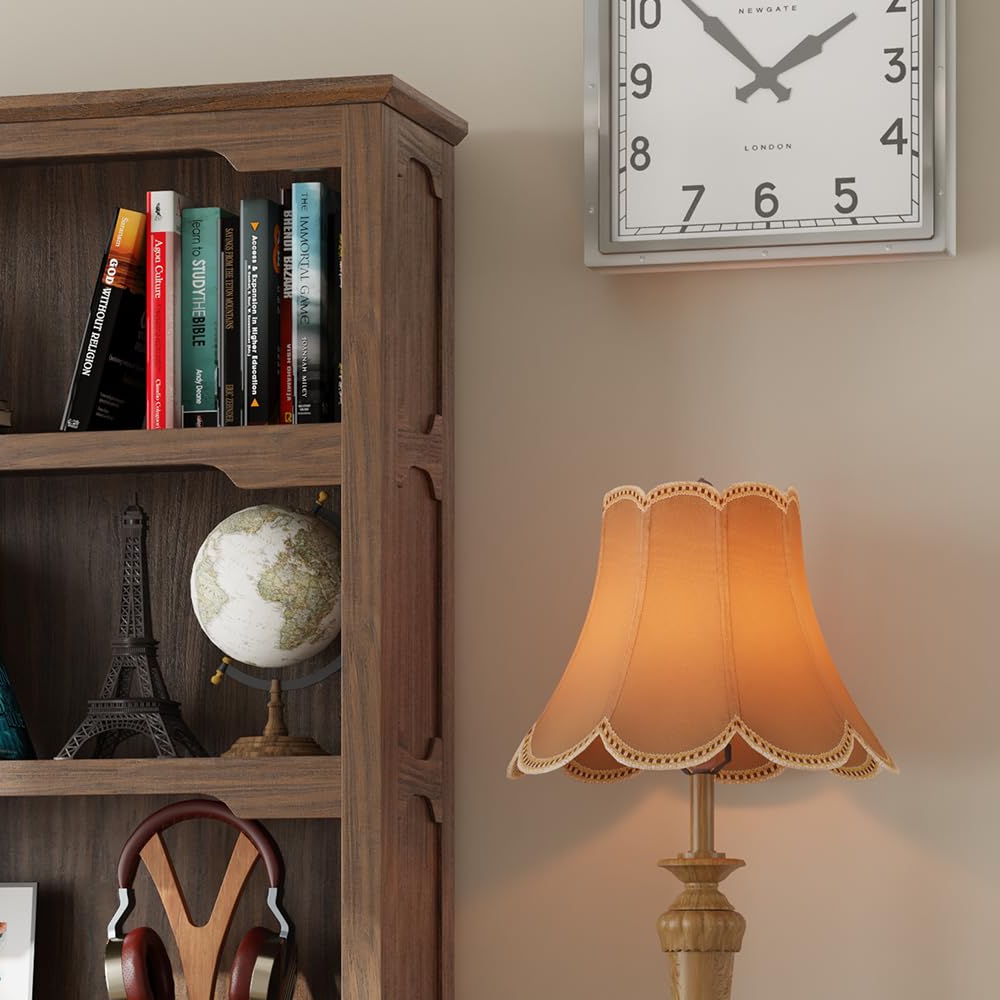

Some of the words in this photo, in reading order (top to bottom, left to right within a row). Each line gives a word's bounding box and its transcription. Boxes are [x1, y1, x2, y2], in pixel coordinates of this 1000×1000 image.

[738, 4, 798, 15] NEWGATE
[630, 62, 652, 100] 9
[884, 47, 907, 84] 3
[630, 136, 651, 172] 8
[744, 142, 794, 152] LONDON
[880, 118, 908, 155] 4
[300, 192, 309, 212] THE
[682, 184, 706, 222] 7
[754, 182, 780, 218] 6
[834, 176, 858, 214] 5
[192, 219, 202, 244] learn
[300, 216, 310, 282] IMMORTAL
[154, 239, 164, 264] Agon
[192, 246, 202, 257] to
[225, 251, 234, 268] FROM
[105, 258, 119, 286] GOD
[154, 264, 164, 299] Culture
[225, 268, 234, 278] THE
[283, 256, 292, 300] BAZAAR
[92, 287, 112, 332] WITHOUT
[250, 274, 258, 314] Expansion
[300, 285, 310, 326] GAME
[250, 316, 258, 325] in
[82, 332, 100, 377] RELIGION
[250, 327, 258, 353] Higher
[195, 368, 204, 384] Andy
